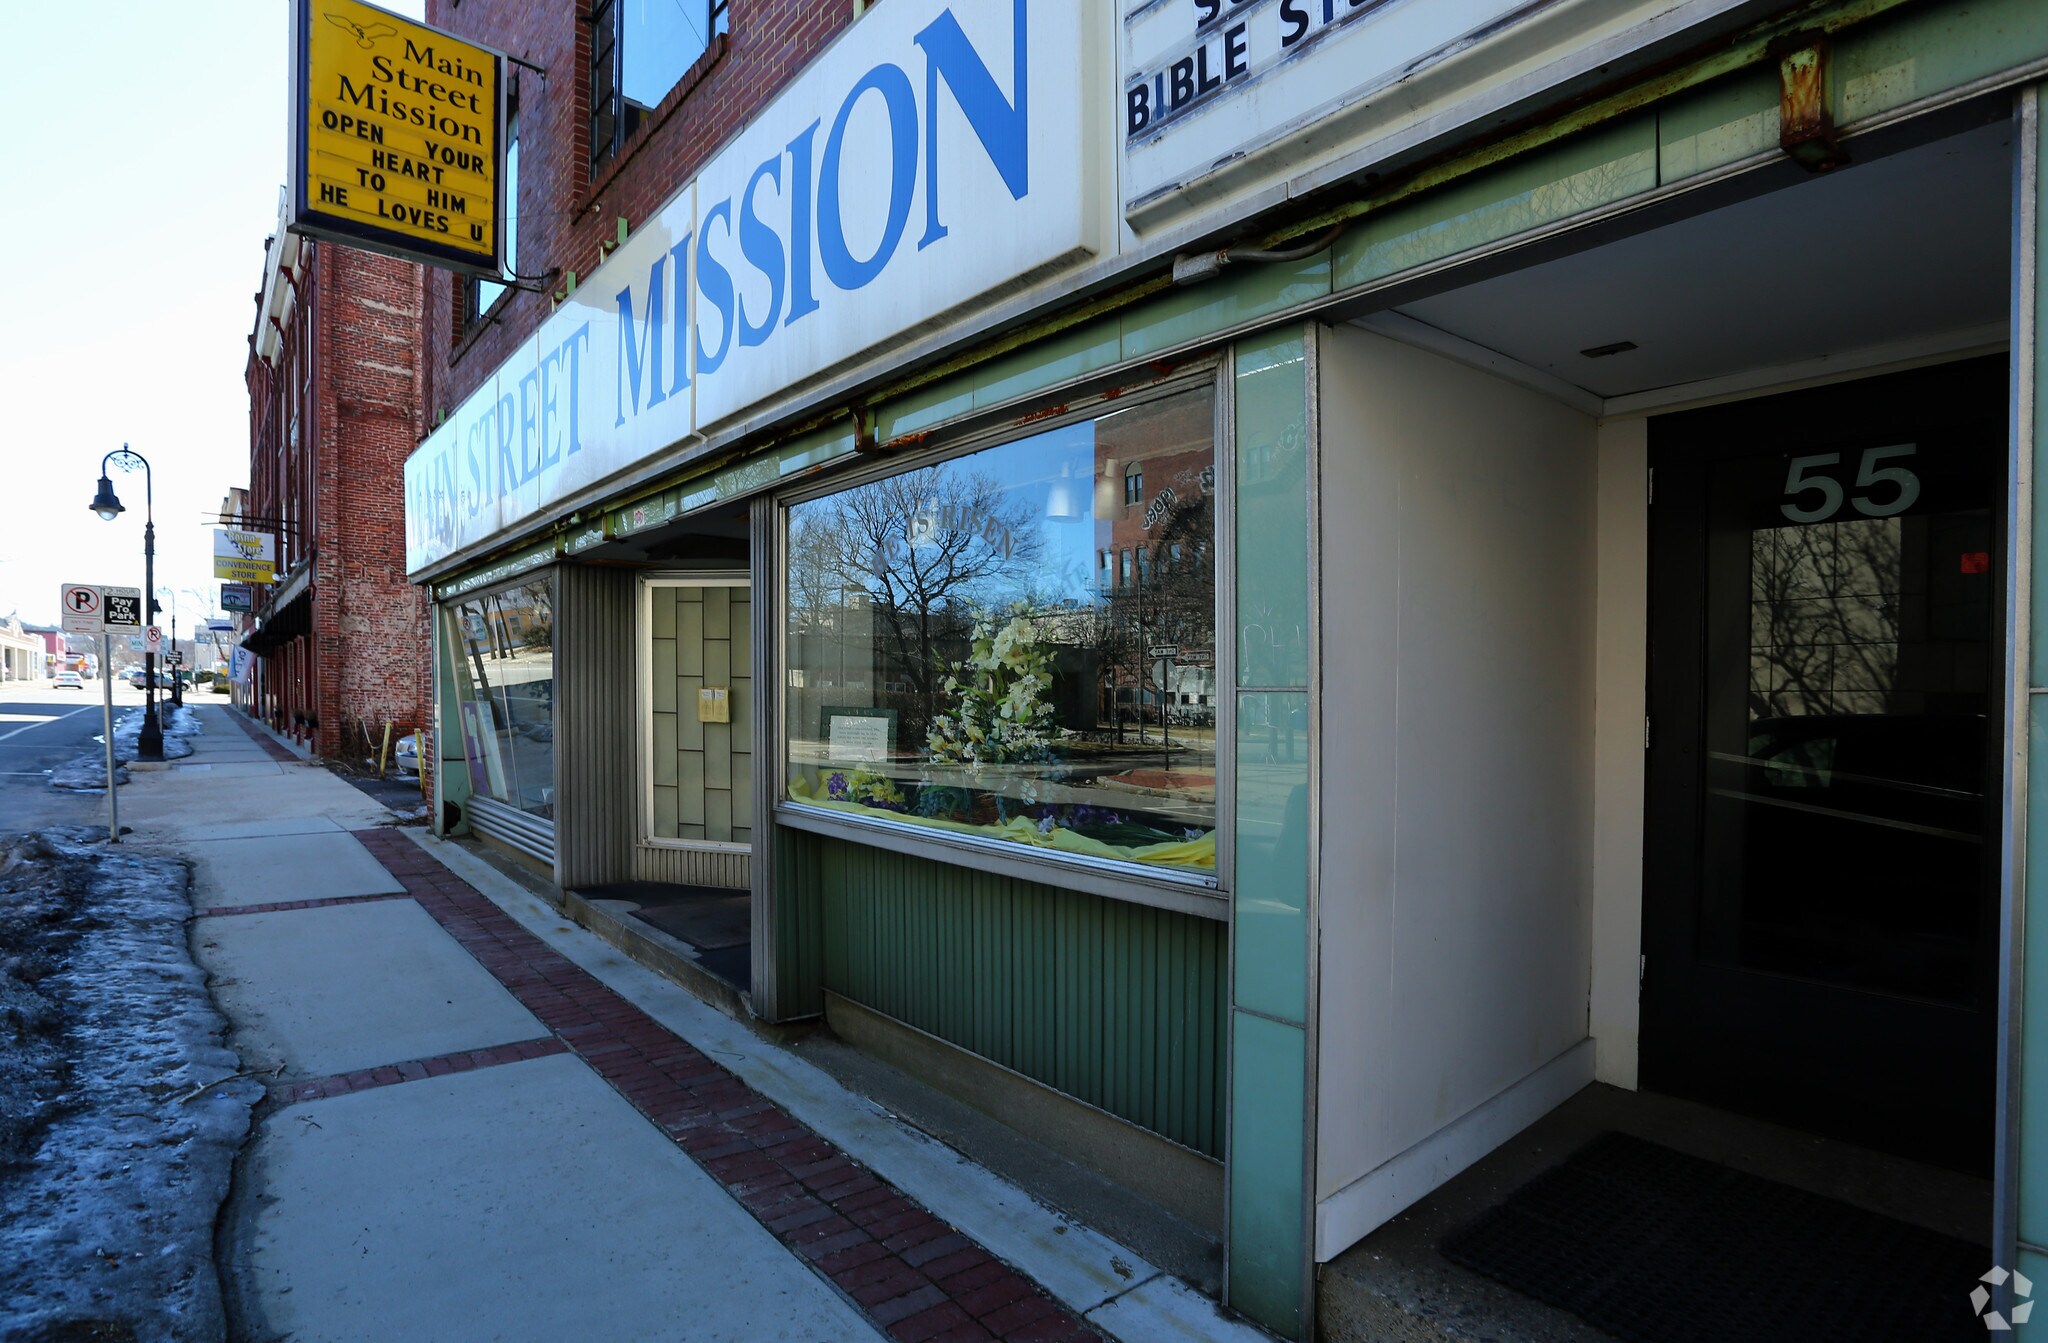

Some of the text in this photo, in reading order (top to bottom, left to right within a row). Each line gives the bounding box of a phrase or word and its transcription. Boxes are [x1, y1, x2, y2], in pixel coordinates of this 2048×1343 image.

[371, 55, 482, 115] Street
[403, 37, 484, 88] Main
[1127, 21, 1247, 137] BIBLE
[336, 73, 483, 146] Mission
[322, 110, 484, 175] OPEN YOUR
[372, 149, 444, 185] HEART
[320, 182, 483, 242] HE LOVES U
[357, 168, 466, 215] TO HIM
[407, 0, 1029, 548] MAIN STREET MISSION
[1779, 442, 1921, 524] 55
[228, 531, 255, 543] Bosna
[237, 543, 261, 555] Store
[906, 510, 929, 541] IS
[940, 504, 1018, 561] RISEN
[216, 560, 272, 572] CONVENIENCE
[231, 570, 257, 579] STORE
[109, 611, 136, 620] Park
[111, 597, 133, 607] Pay
[115, 605, 130, 613] To
